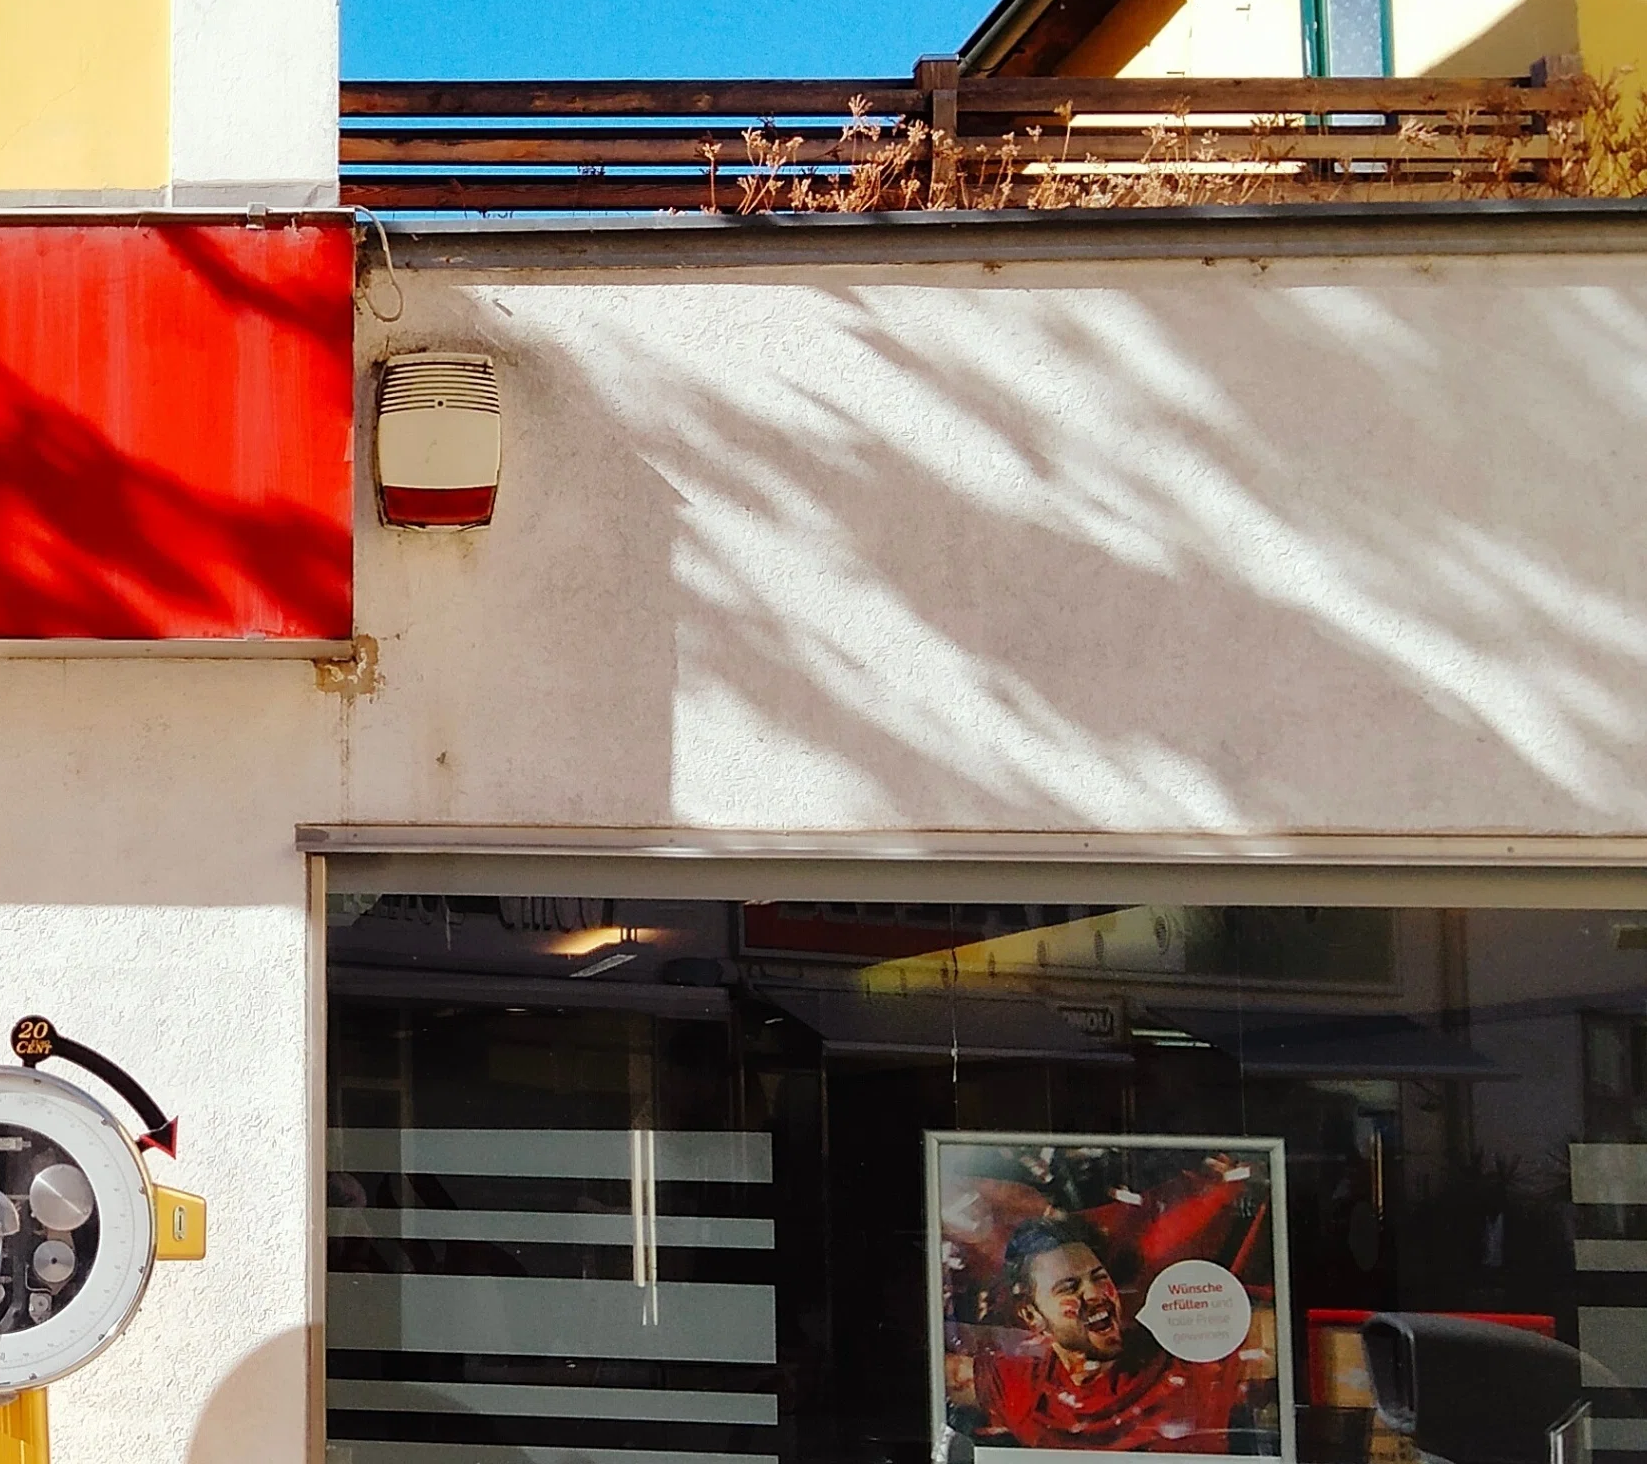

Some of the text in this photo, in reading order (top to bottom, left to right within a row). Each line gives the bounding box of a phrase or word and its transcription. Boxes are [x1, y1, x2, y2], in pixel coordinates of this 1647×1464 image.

[18, 1021, 49, 1039] 20
[15, 1040, 53, 1054] CENT
[1167, 1282, 1223, 1295] Wünsche
[1161, 1298, 1209, 1311] erfüllen
